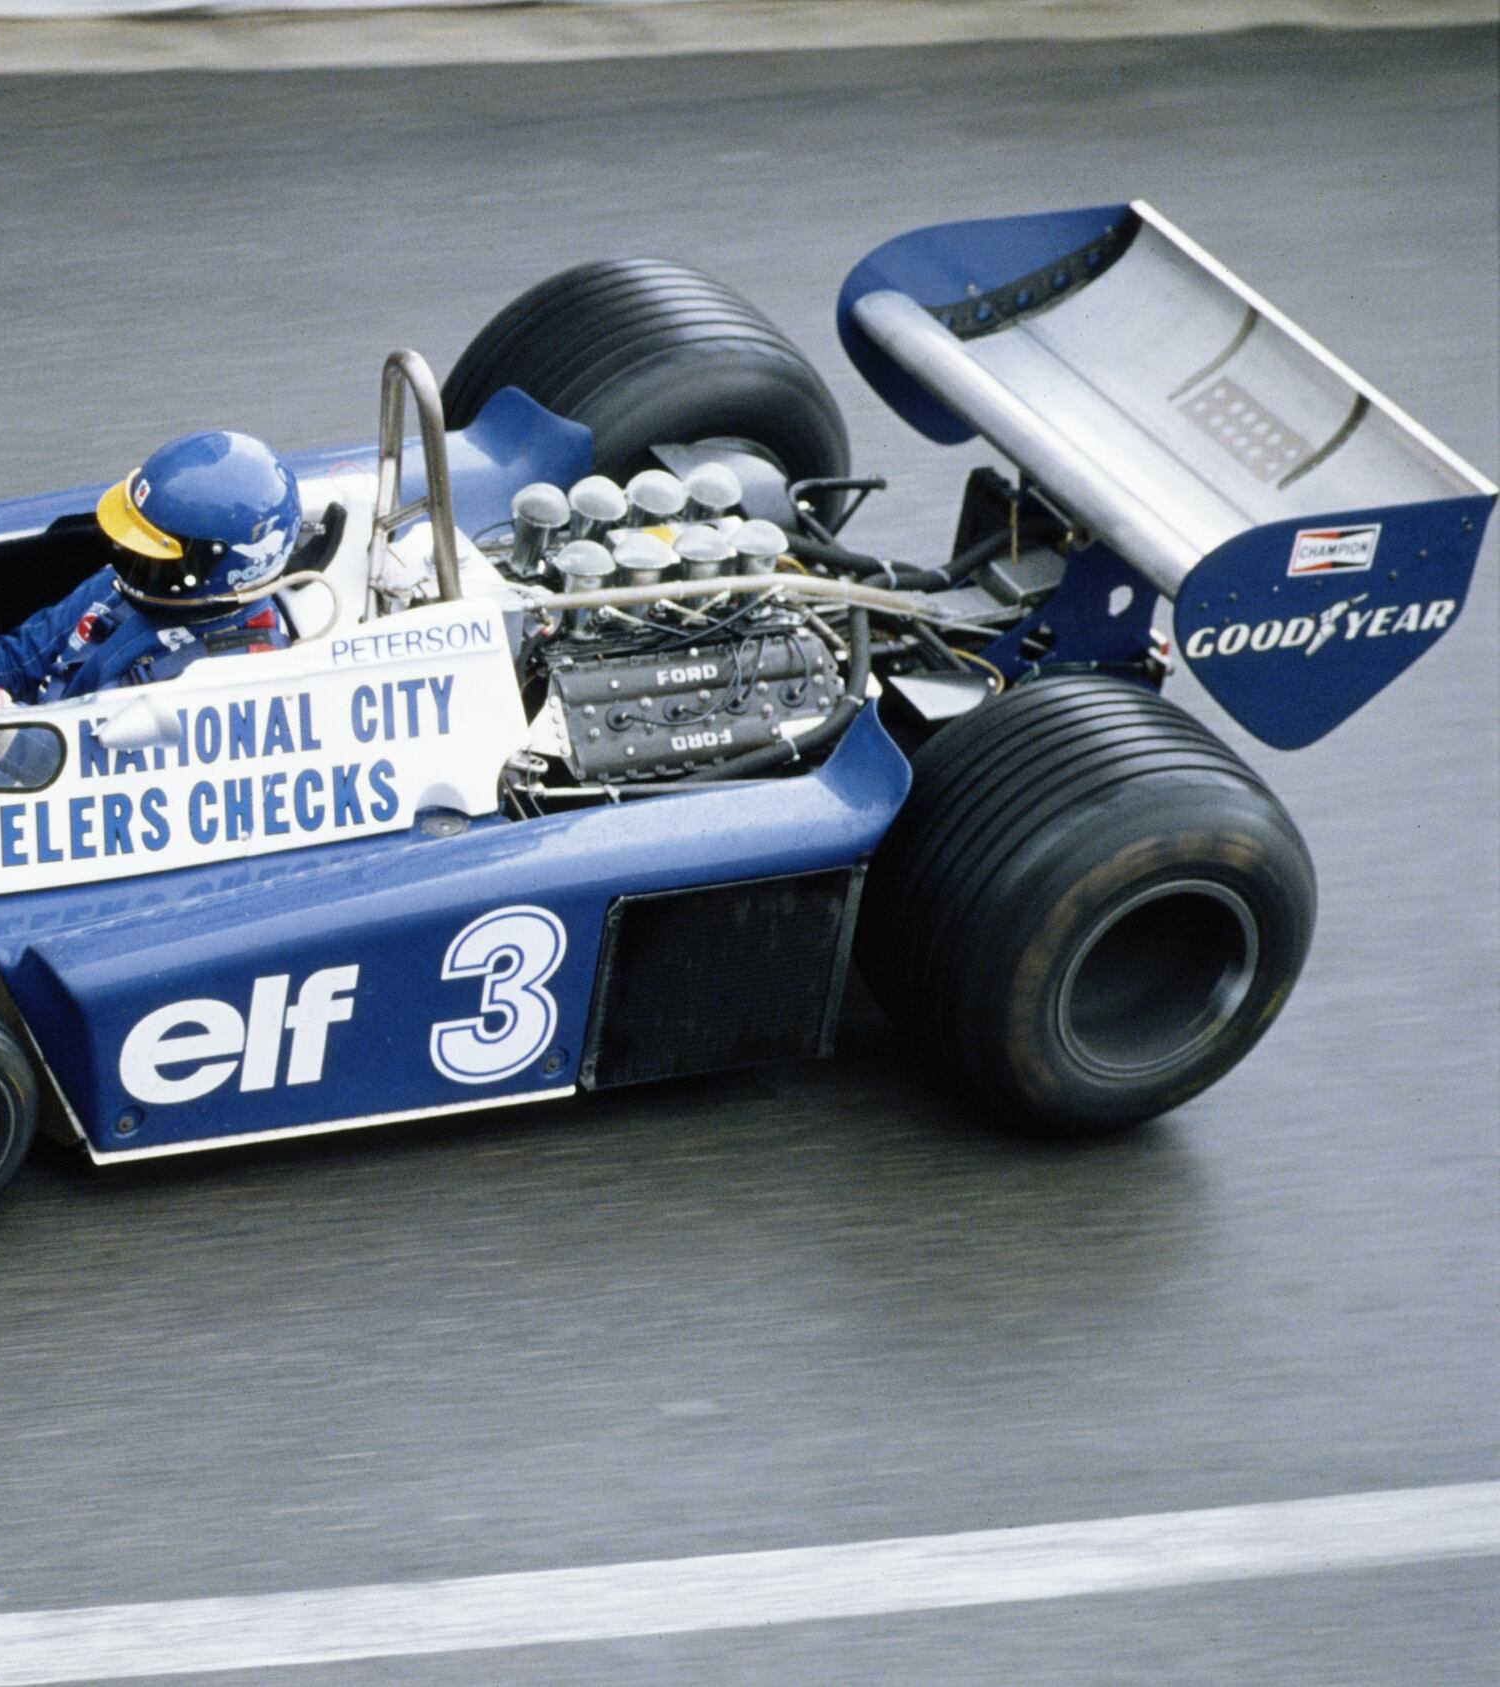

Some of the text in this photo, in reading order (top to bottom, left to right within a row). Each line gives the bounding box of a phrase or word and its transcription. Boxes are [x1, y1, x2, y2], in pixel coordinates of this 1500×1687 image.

[1299, 541, 1367, 560] CHAMPION
[332, 620, 493, 665] PETERSON
[1186, 593, 1455, 658] GOODYEAR
[657, 664, 718, 686] FORD
[351, 675, 455, 744] CITY
[671, 729, 733, 751] FORD
[189, 759, 401, 845] CHECKS
[429, 905, 567, 1084] 3
[119, 964, 360, 1105] elf
